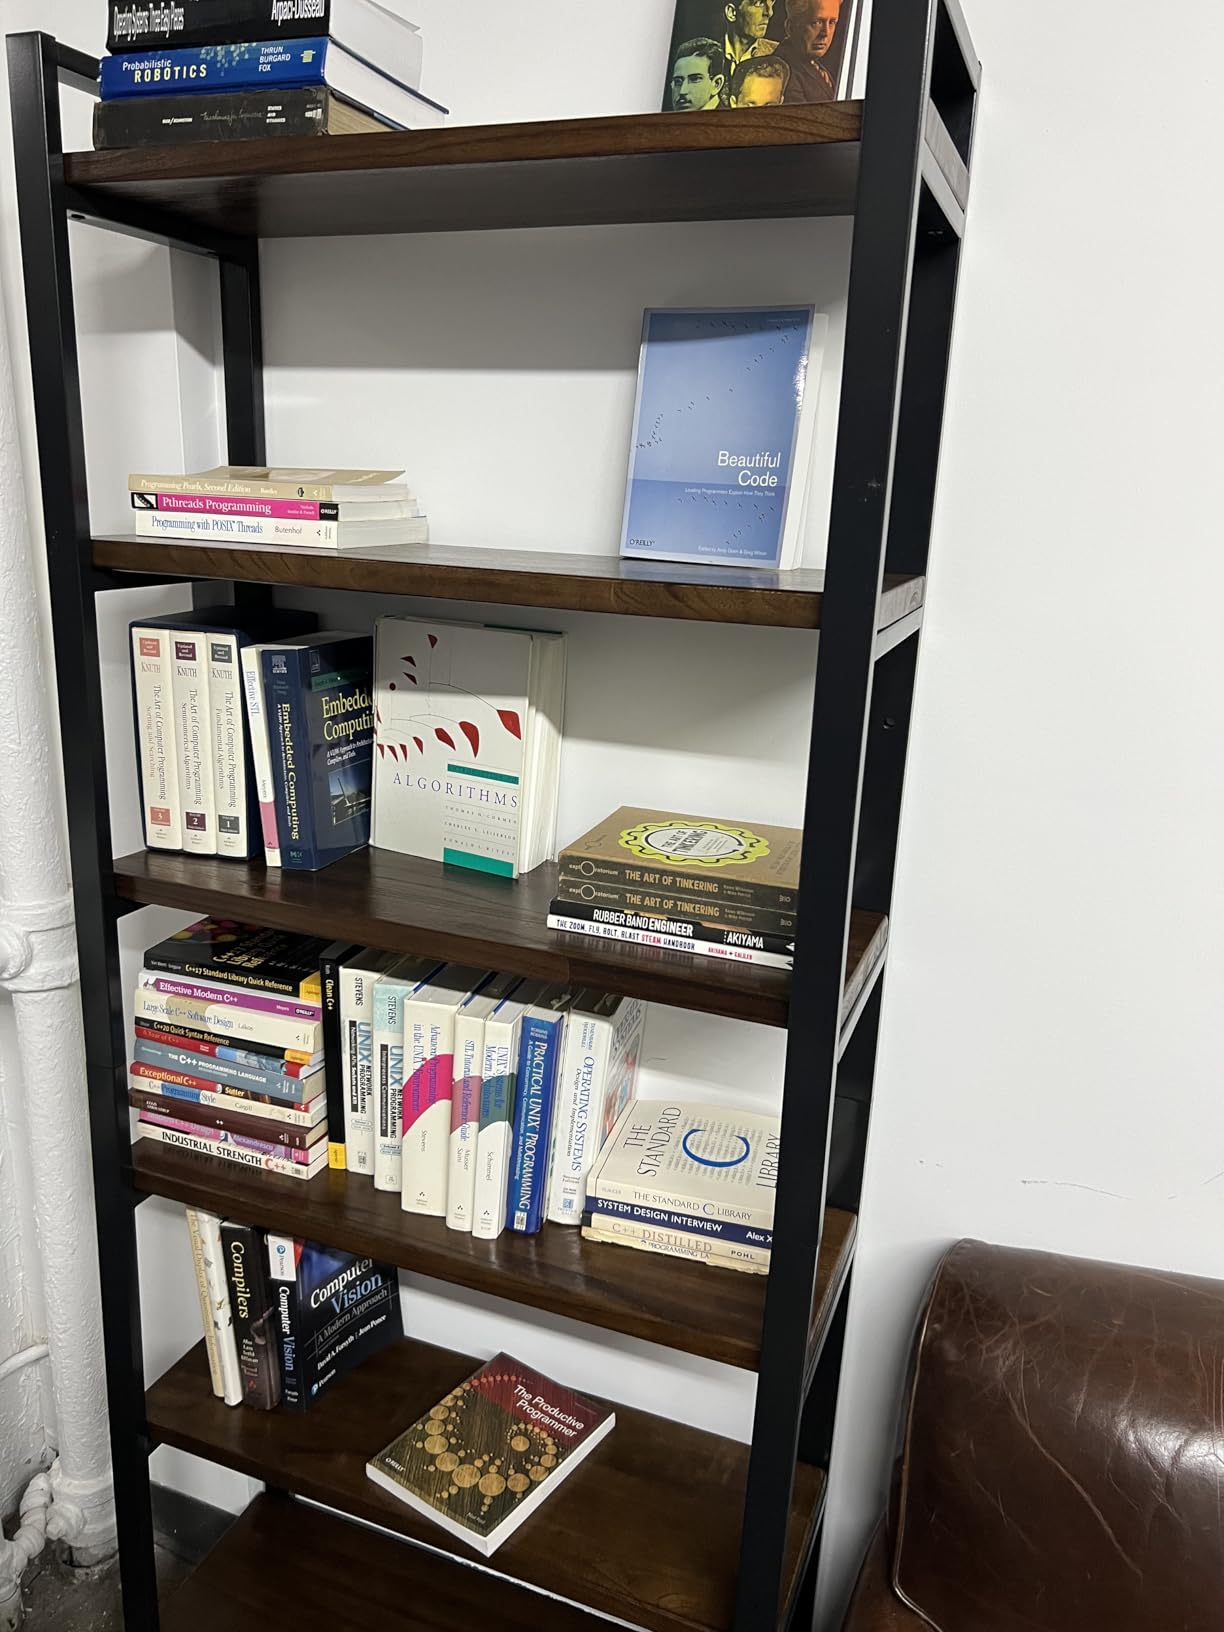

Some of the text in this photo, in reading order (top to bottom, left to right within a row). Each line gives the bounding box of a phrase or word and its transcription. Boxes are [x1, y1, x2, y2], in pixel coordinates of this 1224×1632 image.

[259, 53, 291, 63] BURGARD
[260, 46, 284, 55] THRUN
[122, 58, 172, 71] Probabilistic
[134, 64, 208, 84] ROBOTICS
[258, 64, 271, 73] FOX
[717, 450, 781, 468] Beautiful
[738, 470, 778, 487] Code
[162, 497, 204, 508] Pthreads
[205, 499, 272, 514] Programming
[151, 515, 264, 534] Programming with Threads
[274, 524, 303, 536] Butenhof
[141, 662, 161, 674] KNUTH
[177, 665, 197, 678] KNUTH
[212, 668, 233, 680] KNUTH
[153, 685, 162, 699] The
[154, 720, 165, 755] Computer
[189, 688, 204, 806] The Art Computer Programming
[281, 703, 296, 769] Embedded
[224, 691, 238, 808] The Art Computer Programming
[157, 755, 168, 801] Programming
[393, 772, 518, 808] ALGORITHMS
[287, 771, 300, 840] Computing
[625, 869, 719, 893] THE ART OF TINKERING
[626, 893, 643, 905] THE
[644, 896, 662, 908] ART
[663, 899, 675, 910] OF
[676, 900, 720, 918] TINKERING
[593, 908, 693, 937] RUBBER BAND ENGINEER
[621, 930, 640, 941] BLAST
[641, 934, 662, 945] STEAM
[663, 938, 695, 951] HANDBOOK
[727, 932, 764, 949] AKIYAMA
[185, 964, 203, 975] C++17
[203, 967, 228, 980] Standard
[228, 972, 248, 984] Library
[248, 976, 265, 987] Quick
[265, 979, 293, 992] Reference
[325, 979, 335, 998] Clean
[159, 981, 238, 1004] Effective Modern C++
[327, 998, 335, 1010] C++
[354, 977, 363, 1006] STEVENS
[187, 1011, 235, 1029] Software Design
[387, 995, 397, 1025] STEVENS
[154, 1021, 170, 1032] C++20
[170, 1025, 186, 1036] Quick
[186, 1029, 203, 1041] Syntax
[203, 1033, 230, 1046] Reference
[358, 1022, 372, 1064] UNIX
[413, 1023, 423, 1044] in the
[430, 1023, 441, 1057] Advanced
[464, 1039, 475, 1054] STL
[484, 1044, 497, 1072] Modern
[139, 1067, 183, 1084] Exceptional
[183, 1076, 197, 1086] C++
[179, 1054, 197, 1067] C++
[198, 1060, 238, 1076] PROGRAMMING
[237, 1070, 268, 1083] LANGUAGE
[389, 1045, 403, 1087] UNIX
[463, 1054, 475, 1079] Tutorial
[224, 1086, 245, 1097] Sutter
[359, 1064, 367, 1115] PROGRAMMING
[462, 1079, 472, 1092] and
[573, 1068, 582, 1090] Design
[200, 1090, 217, 1104] Style
[389, 1088, 397, 1139] PROGRAMMING
[518, 1041, 547, 1210] PRACTICAL UNIX PROGRAMMING
[571, 1056, 595, 1172] OPERATING SYSTEMS
[459, 1123, 470, 1142] Guide
[566, 1107, 577, 1157] Implementation
[623, 1124, 652, 1149] THE
[636, 1106, 682, 1177] STANDARD
[162, 1131, 288, 1172] INDUSTRIAL STRENGTH C++
[682, 1128, 751, 1168] C
[755, 1133, 781, 1189] LIBRARY
[597, 1199, 723, 1233] SYSTEM DESIGN INTERVIEW
[633, 1190, 753, 1221] THE STANDARD C LIBRARY
[190, 1213, 199, 1228] The
[612, 1223, 713, 1252] C++ DISTILLED
[746, 1230, 765, 1242] Alex
[730, 1249, 756, 1260] POHL
[230, 1240, 251, 1319] Compilers
[331, 1273, 382, 1314] Vision
[278, 1286, 290, 1335] Computer
[317, 1288, 388, 1345] A Modern Approach
[371, 1314, 388, 1329] Ponce
[283, 1335, 295, 1372] Vision
[514, 1384, 585, 1431] The Productive
[516, 1399, 578, 1438] Programmer
